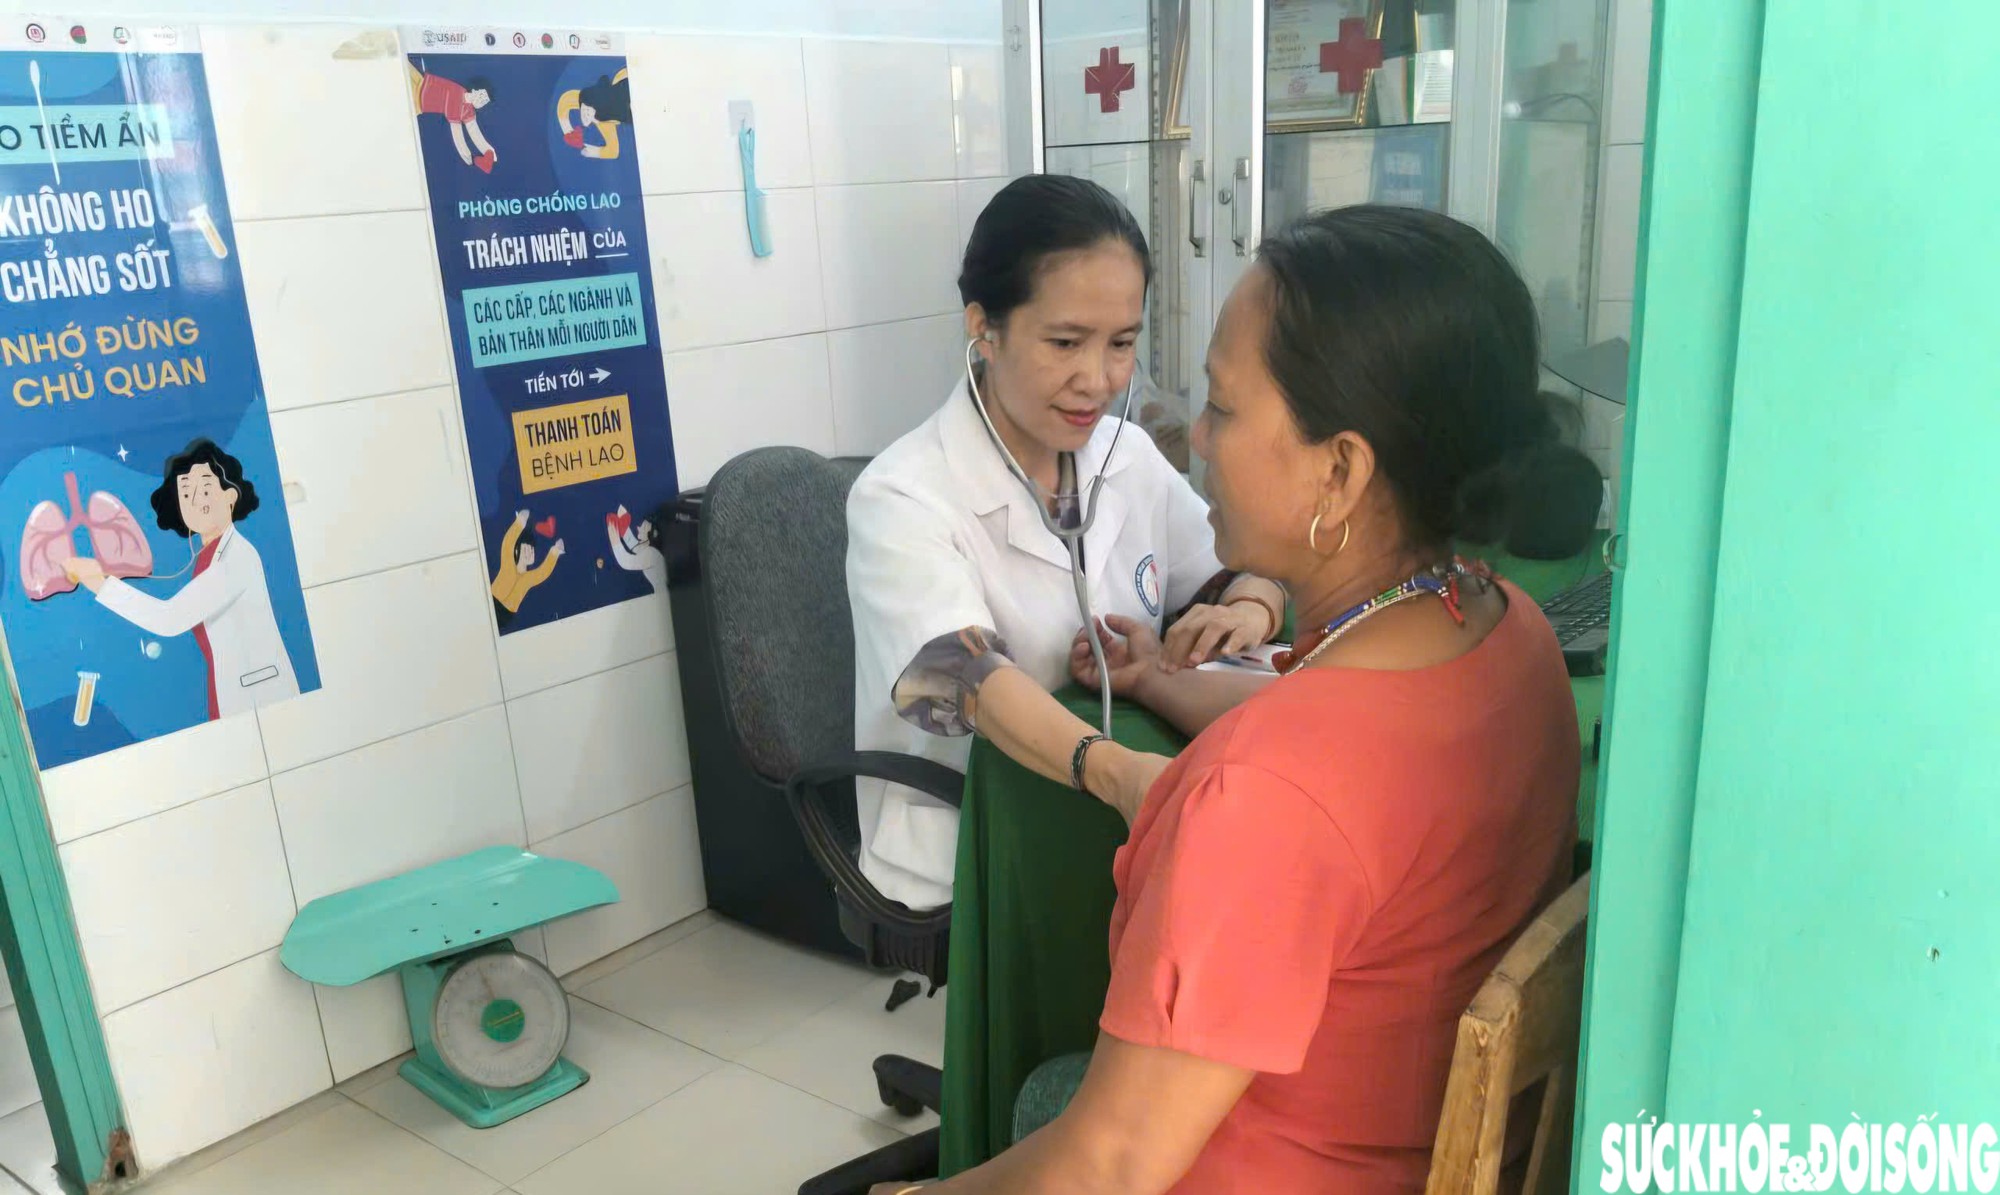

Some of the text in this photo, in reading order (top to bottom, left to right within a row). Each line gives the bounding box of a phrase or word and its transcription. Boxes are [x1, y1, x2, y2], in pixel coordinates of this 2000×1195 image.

[30, 113, 107, 150] TIỀM
[118, 112, 161, 148] ẨN
[0, 185, 156, 238] KHÔNG HO
[458, 190, 621, 219] PHÒNG CHỐNG LAO
[463, 227, 627, 270] TRÁCH NHIỆM CỦA
[0, 239, 171, 303] CHẲNG SỐT
[473, 282, 634, 324] CÁC CẤP, CÁC NGÀNH VÀ
[1, 315, 200, 367] NHỚ ĐỪNG
[478, 328, 507, 356] BẢN
[509, 326, 545, 352] THÂN
[547, 318, 571, 347] MỖI
[613, 314, 638, 338] DÂN
[13, 356, 207, 407] CHỦ QUAN
[524, 368, 585, 394] TIẾN TỚI
[524, 405, 622, 449] THANH TOÁN
[532, 443, 624, 480] BỆNH LAO
